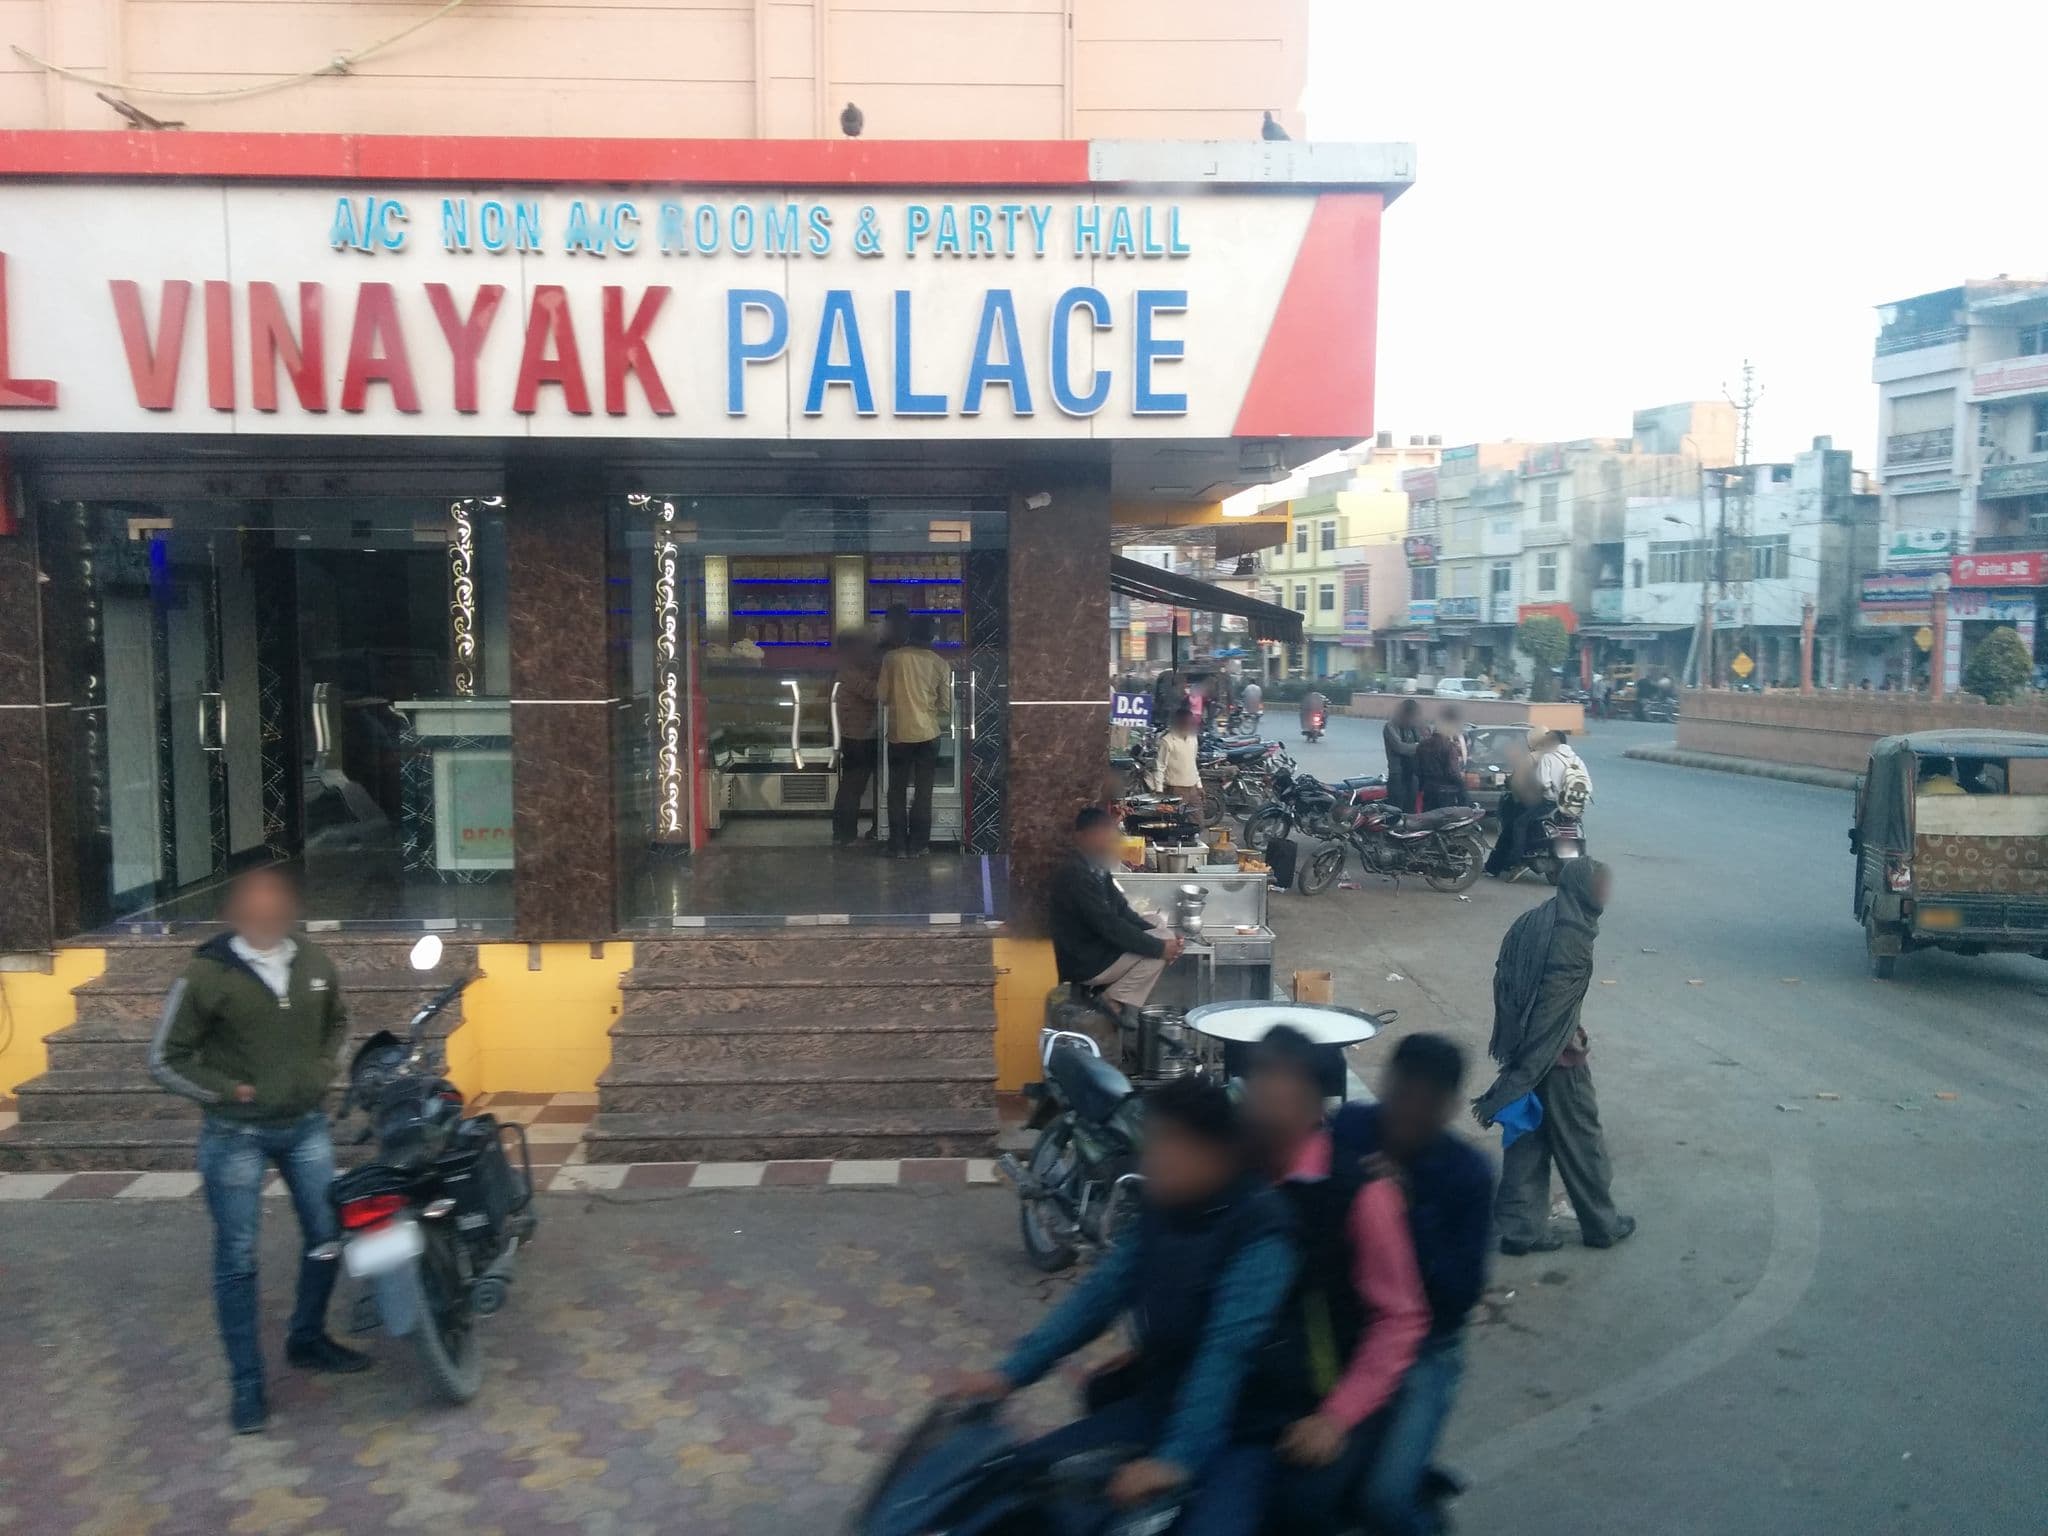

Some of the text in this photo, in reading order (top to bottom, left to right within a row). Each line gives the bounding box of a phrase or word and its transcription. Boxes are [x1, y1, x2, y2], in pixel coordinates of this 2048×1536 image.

[329, 195, 1192, 257] A/C NON A/C ROOMS & PARTY HALL
[108, 279, 676, 416] VINAYAK
[725, 286, 1190, 417] PALACE
[1116, 695, 1149, 715] D.C.
